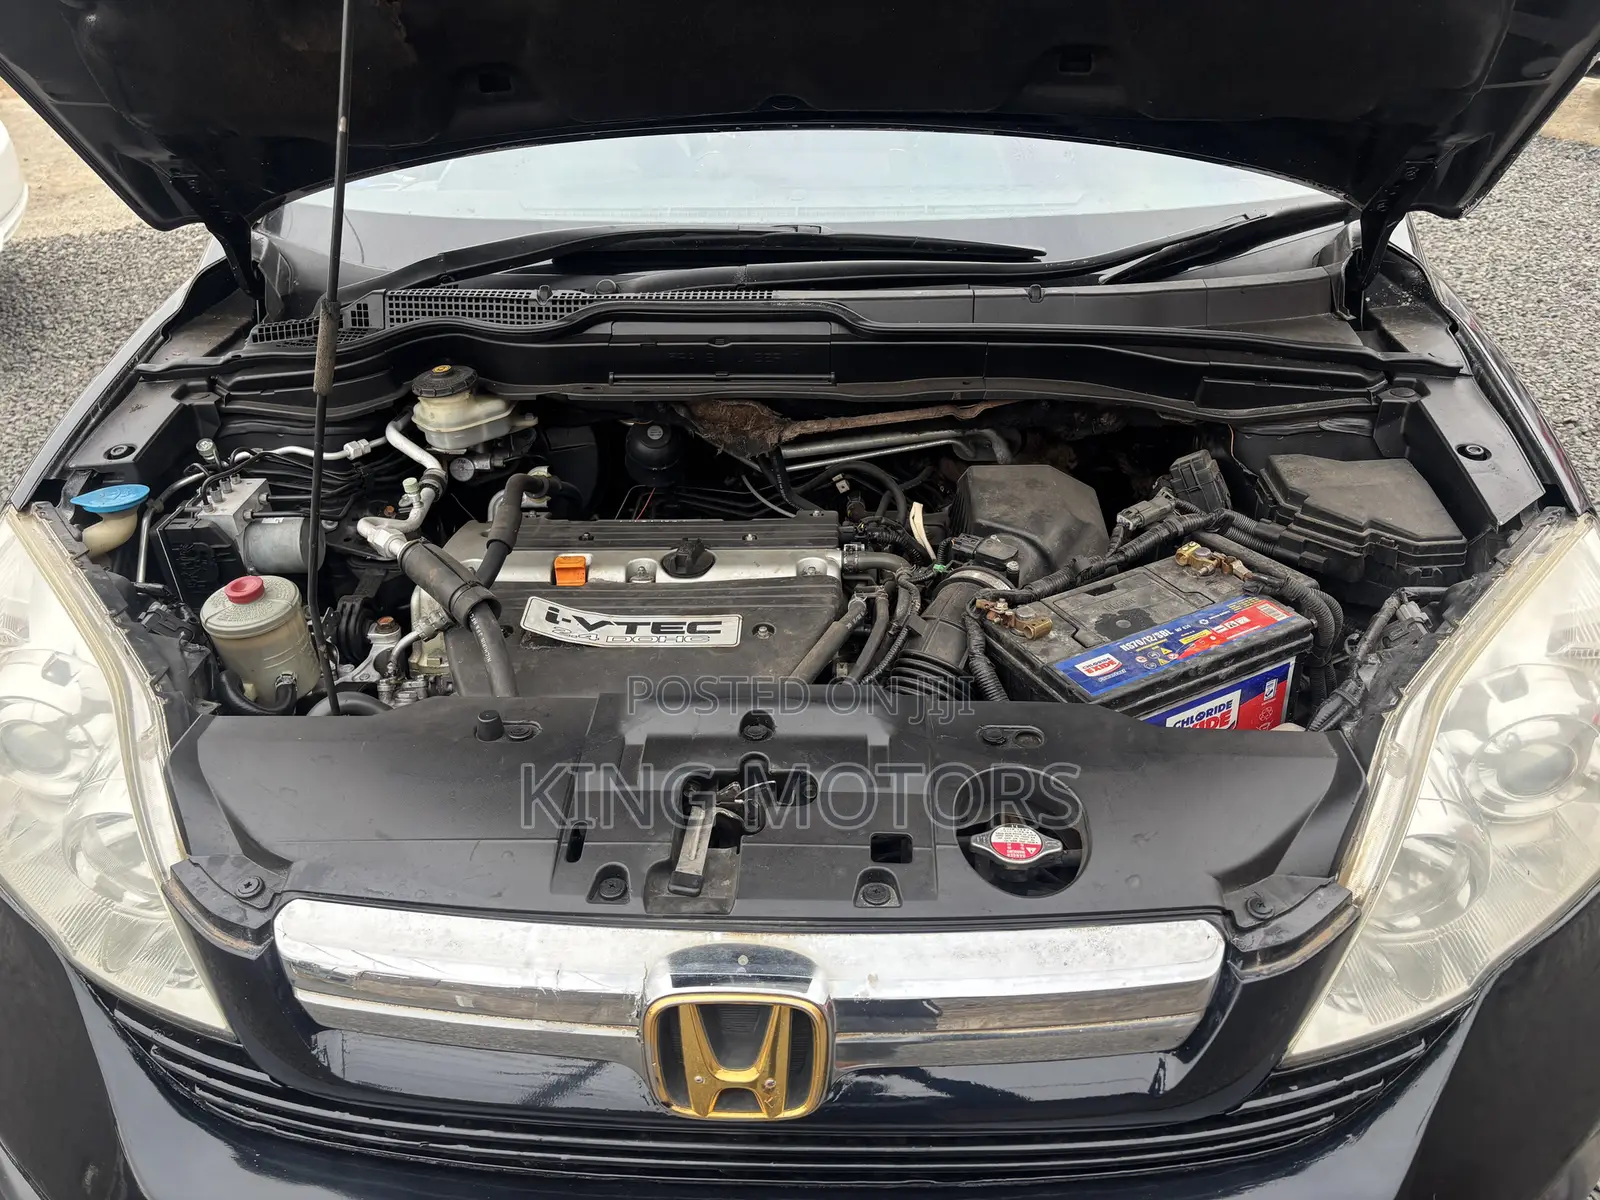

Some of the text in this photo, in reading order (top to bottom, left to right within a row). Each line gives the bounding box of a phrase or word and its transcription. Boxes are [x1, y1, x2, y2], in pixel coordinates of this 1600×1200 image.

[545, 606, 722, 635] i-VTEC
[552, 626, 711, 644] 2.4 DOHC
[1084, 660, 1117, 674] EXIDE
